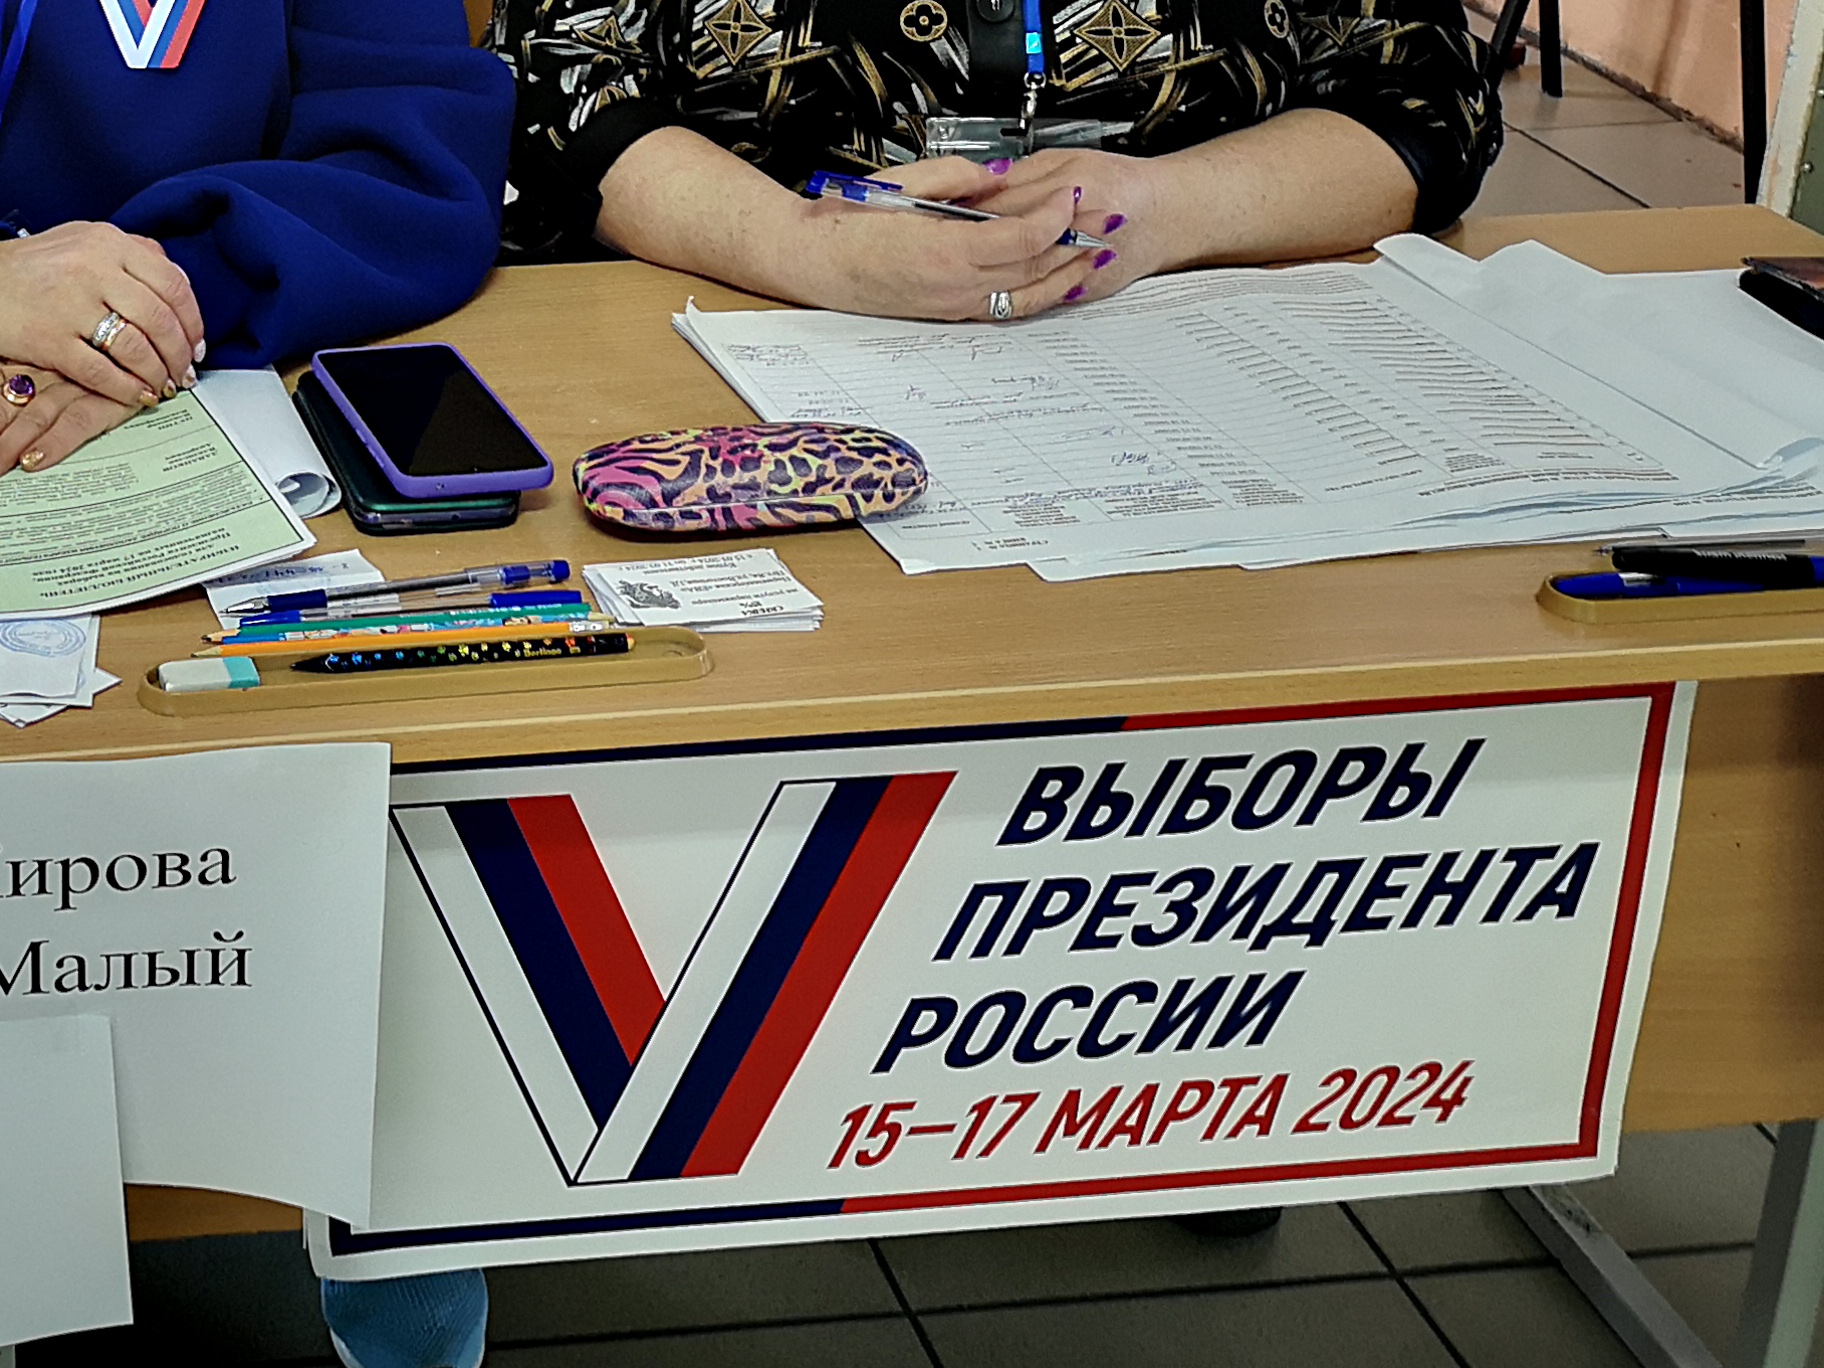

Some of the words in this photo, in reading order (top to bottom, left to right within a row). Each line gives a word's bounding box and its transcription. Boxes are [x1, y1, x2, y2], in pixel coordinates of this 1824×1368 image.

[997, 739, 1486, 845] ВЫБОРЫ
[933, 843, 1598, 960] ПРЕЗИДЕНТА
[872, 971, 1305, 1073] РОССИИ
[1036, 1074, 1289, 1153] МАРТА
[1292, 1061, 1474, 1134] 2024
